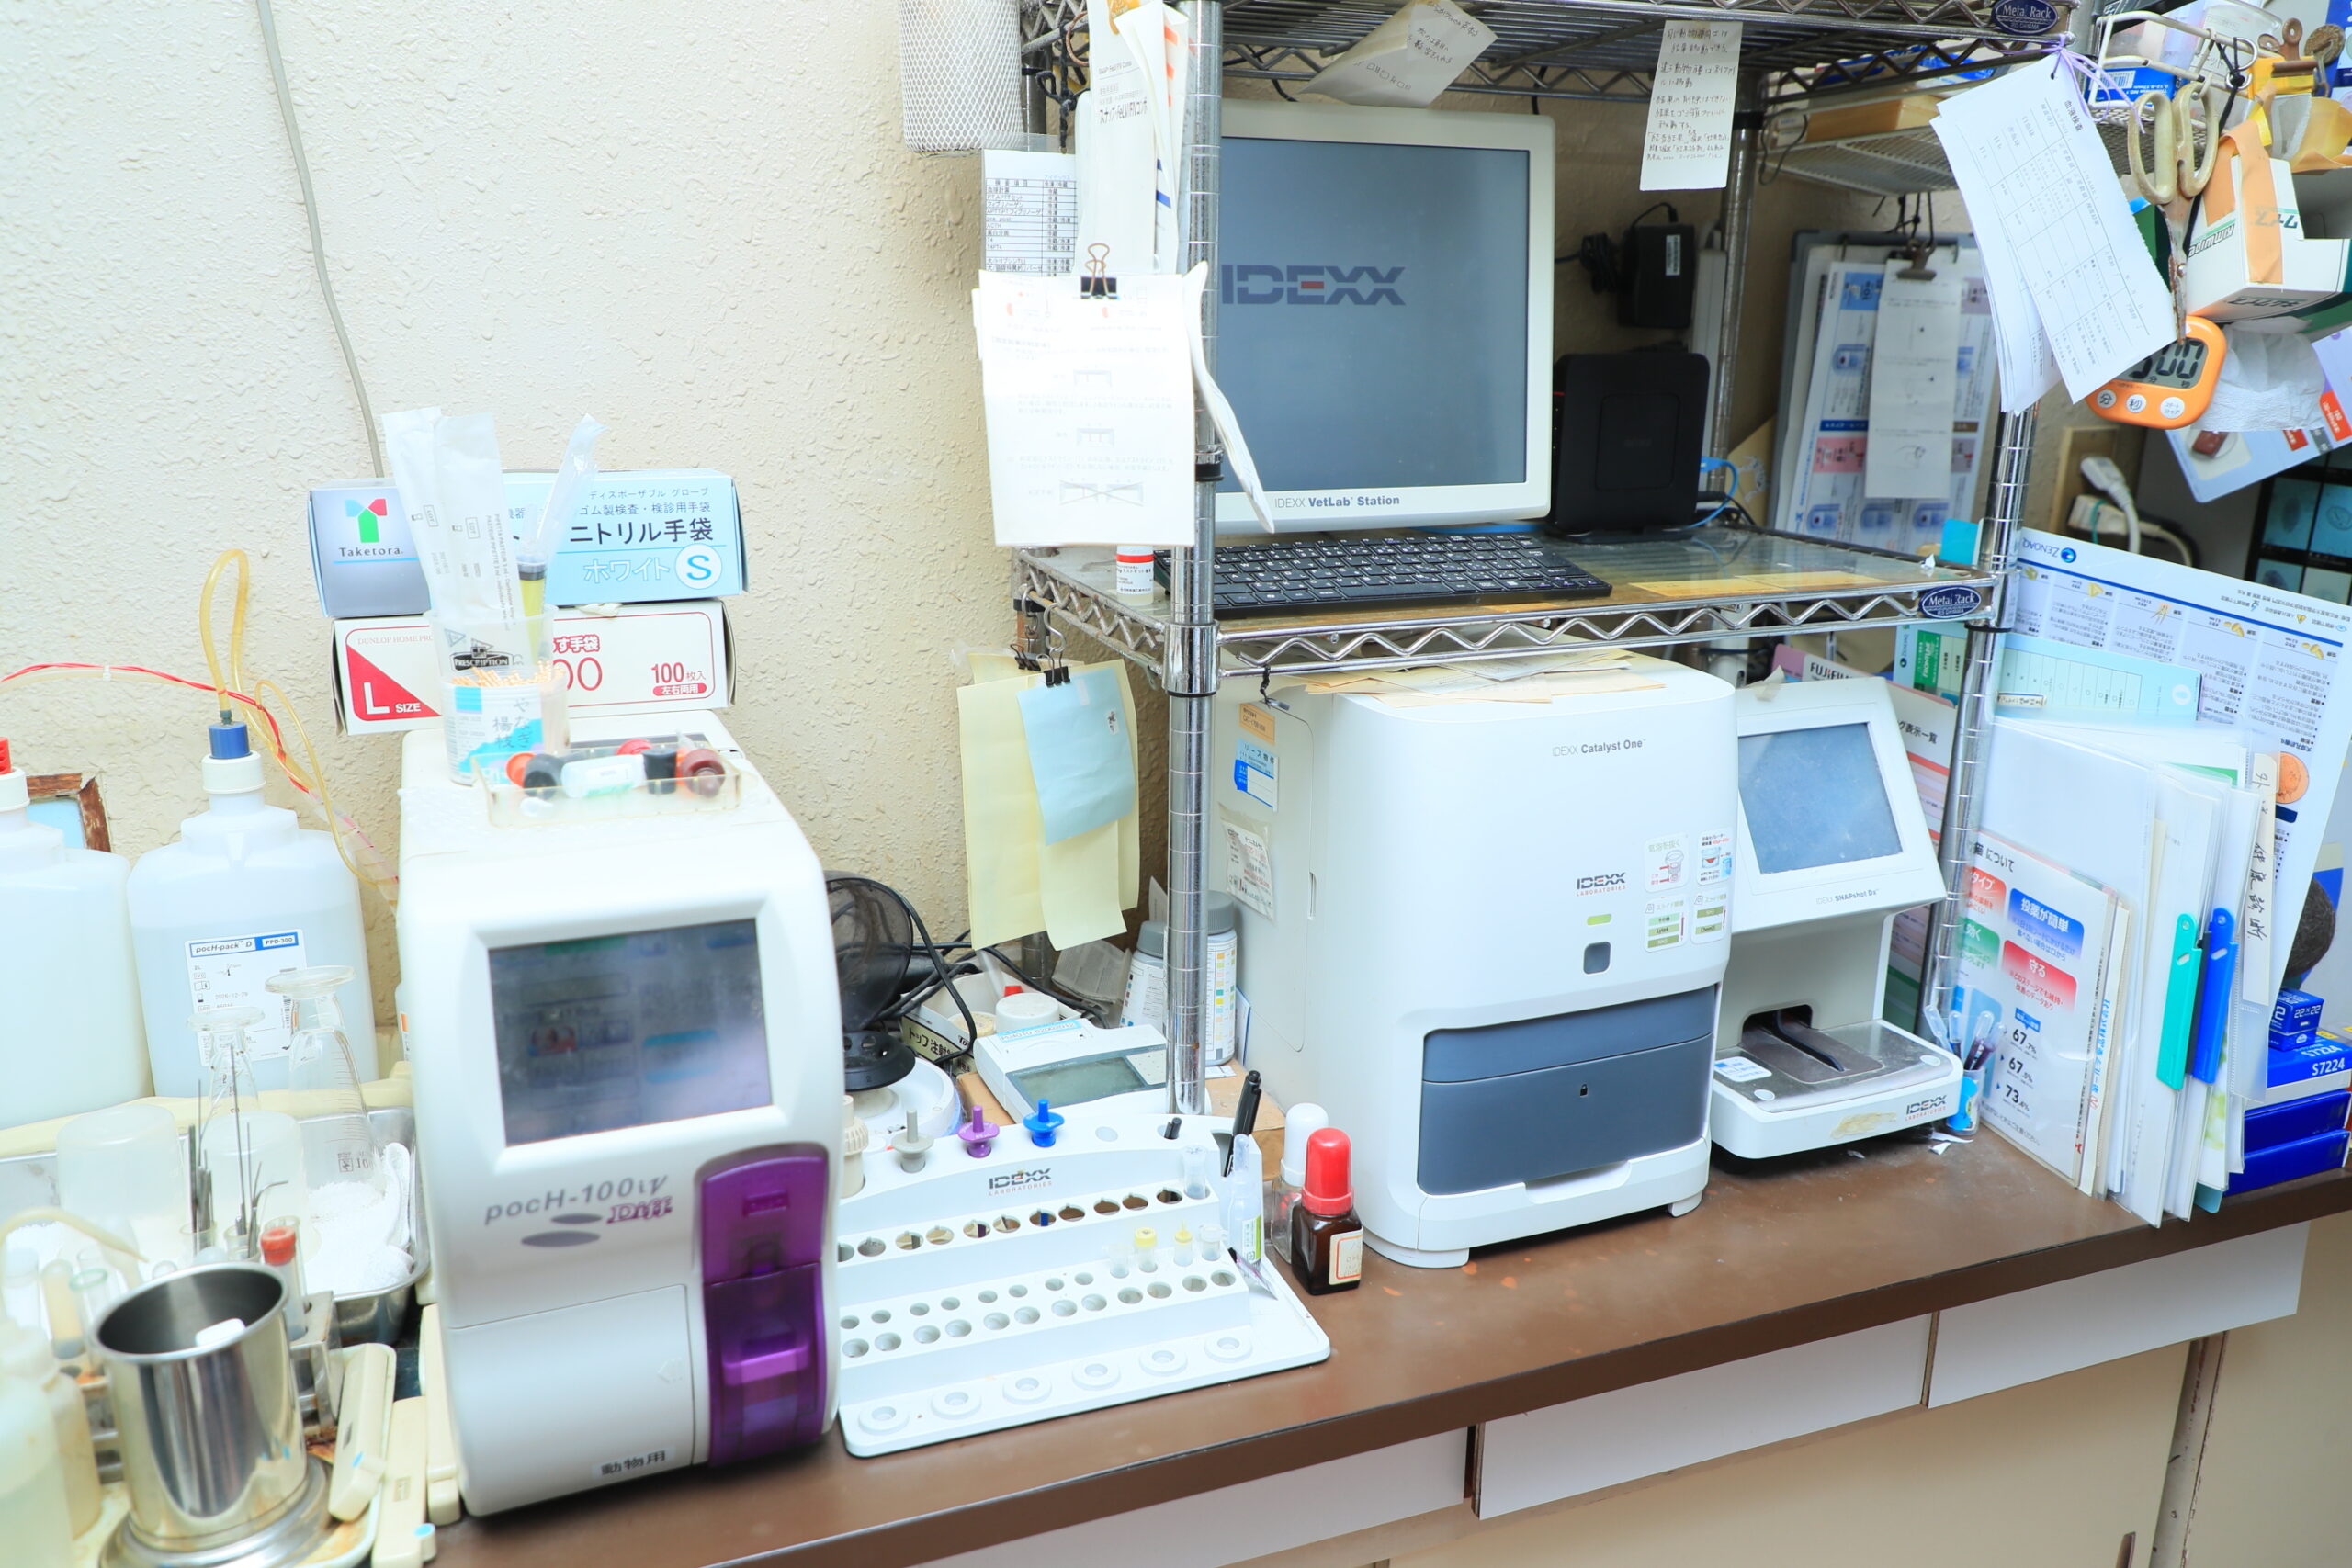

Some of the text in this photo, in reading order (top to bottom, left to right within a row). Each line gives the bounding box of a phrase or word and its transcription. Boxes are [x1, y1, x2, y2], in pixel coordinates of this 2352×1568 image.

[2004, 5, 2051, 18] Meta Rack
[2062, 99, 2085, 132] 血液検査
[1222, 265, 1406, 305] IDEXX
[2100, 393, 2143, 410] 分 秒
[590, 488, 708, 499] ディスポーザブル グローブ
[1274, 495, 1400, 508] IDEXX VetLab Station
[580, 502, 710, 516] ゴム製検査・検診用手袋
[571, 517, 713, 545] ニトリル手袋
[339, 547, 401, 558] Taketora
[583, 558, 669, 584] ホワイト
[687, 555, 711, 580] S
[357, 637, 391, 645] DUNLOP
[662, 684, 698, 694] 左右両用
[364, 682, 421, 714] L SIZE
[514, 698, 530, 748] やなぎ
[492, 716, 513, 749] 楊枝
[1553, 739, 1643, 757] IDEXX Catalyst One
[1577, 873, 1625, 889] IDEXX
[1577, 886, 1626, 897] LABORATORIES
[1835, 891, 1866, 902] SNAPshot
[2312, 1057, 2345, 1076] S7224
[1905, 1106, 1946, 1121] LABORATORIES
[1906, 1095, 1946, 1115] IDEXX
[989, 1168, 1051, 1189] IDEXX
[989, 1181, 1052, 1196] LABORATORIES
[601, 1450, 666, 1476] 動物用
